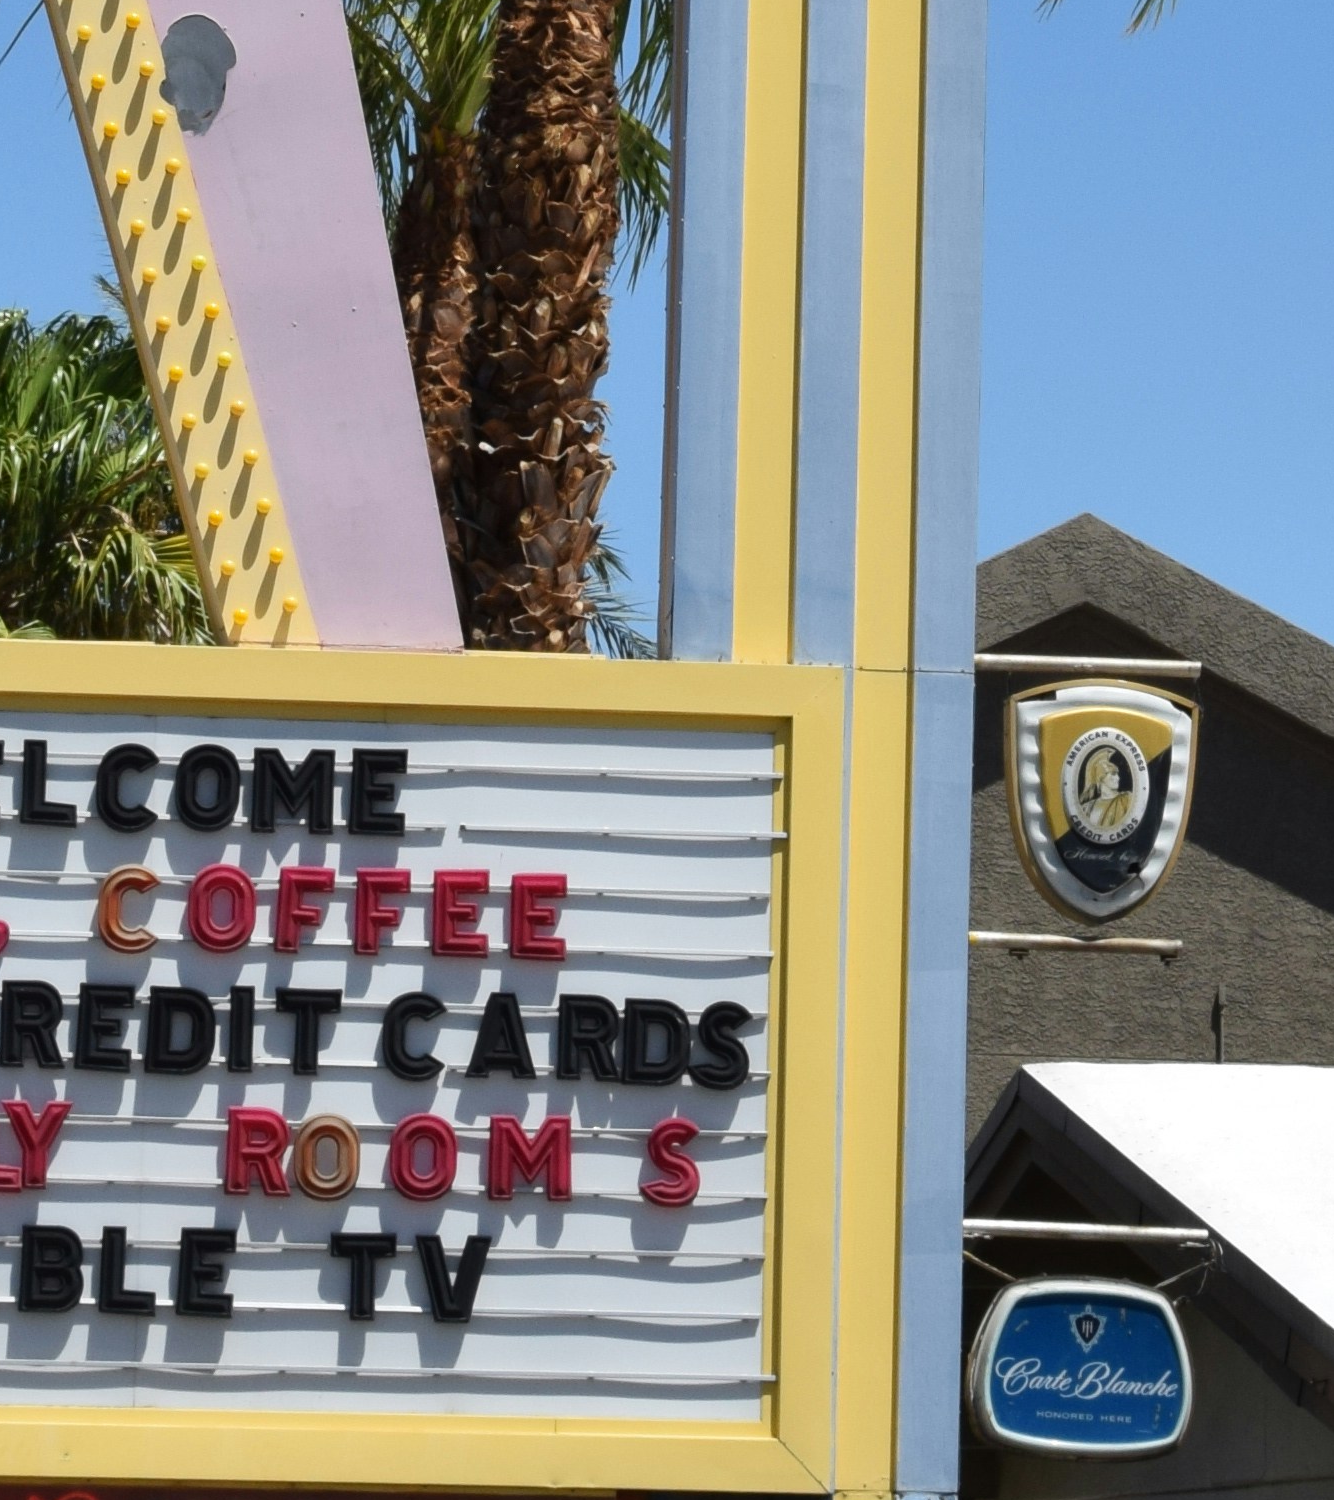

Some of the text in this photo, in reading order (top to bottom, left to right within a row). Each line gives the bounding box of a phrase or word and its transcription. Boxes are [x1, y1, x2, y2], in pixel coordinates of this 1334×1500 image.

[1067, 731, 1146, 772] AMERICAN EXPRESS
[1070, 814, 1139, 842] CREDIT CARDS
[98, 863, 569, 961] COFFEE
[375, 991, 754, 1094] CARDS
[325, 1232, 494, 1328] TV
[995, 1357, 1179, 1400] Carte Blanche
[1036, 1410, 1132, 1424] HONORED HERE
